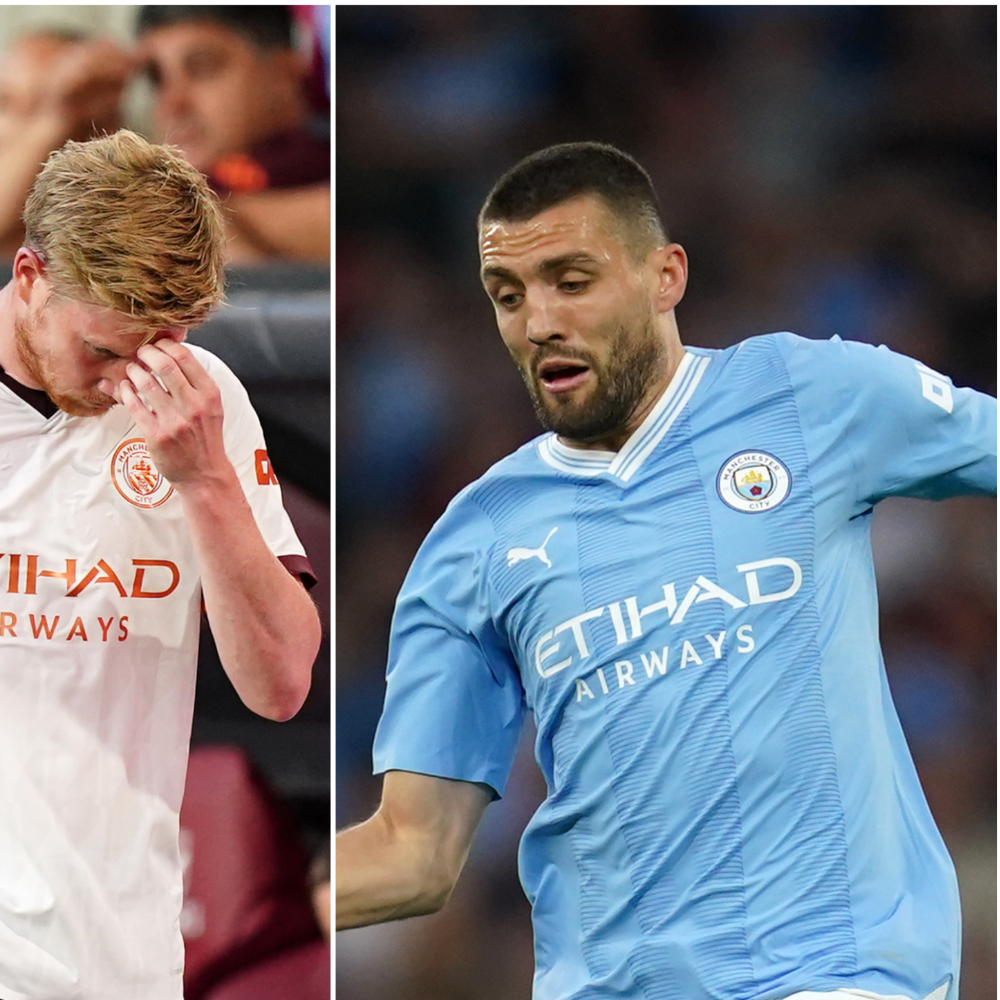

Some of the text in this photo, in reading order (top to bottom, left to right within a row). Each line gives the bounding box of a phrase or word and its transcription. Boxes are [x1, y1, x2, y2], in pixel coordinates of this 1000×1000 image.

[723, 455, 780, 481] MANCHESTER
[749, 501, 770, 509] CITY
[534, 557, 803, 679] ETIHAD
[575, 624, 756, 703] AIRWAYS
